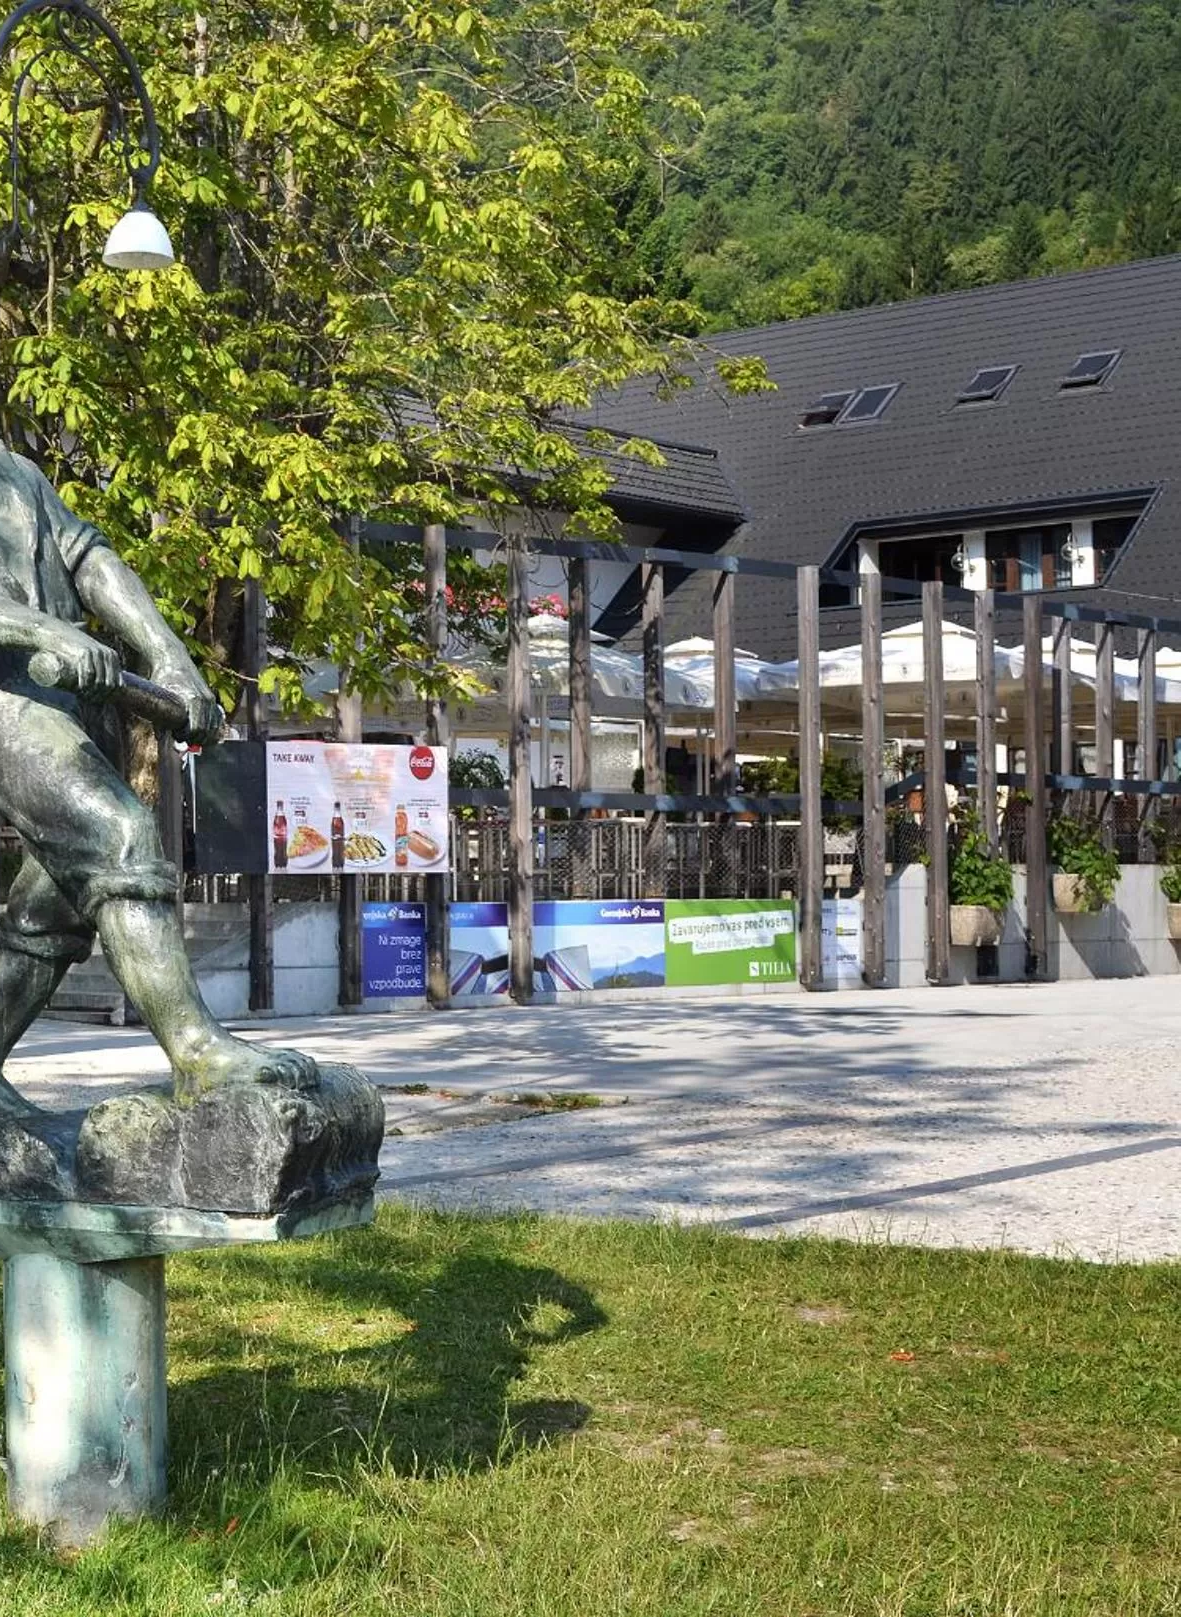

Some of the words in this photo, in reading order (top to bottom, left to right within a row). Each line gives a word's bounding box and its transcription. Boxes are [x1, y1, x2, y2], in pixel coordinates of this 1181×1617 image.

[273, 753, 292, 763] TAKE
[399, 910, 422, 919] Banka
[378, 935, 388, 946] Ni
[390, 935, 422, 947] zmage
[400, 949, 422, 960] brez
[396, 964, 422, 976] prave
[761, 961, 792, 976] TILIA
[369, 977, 424, 990] vzpodbude.
